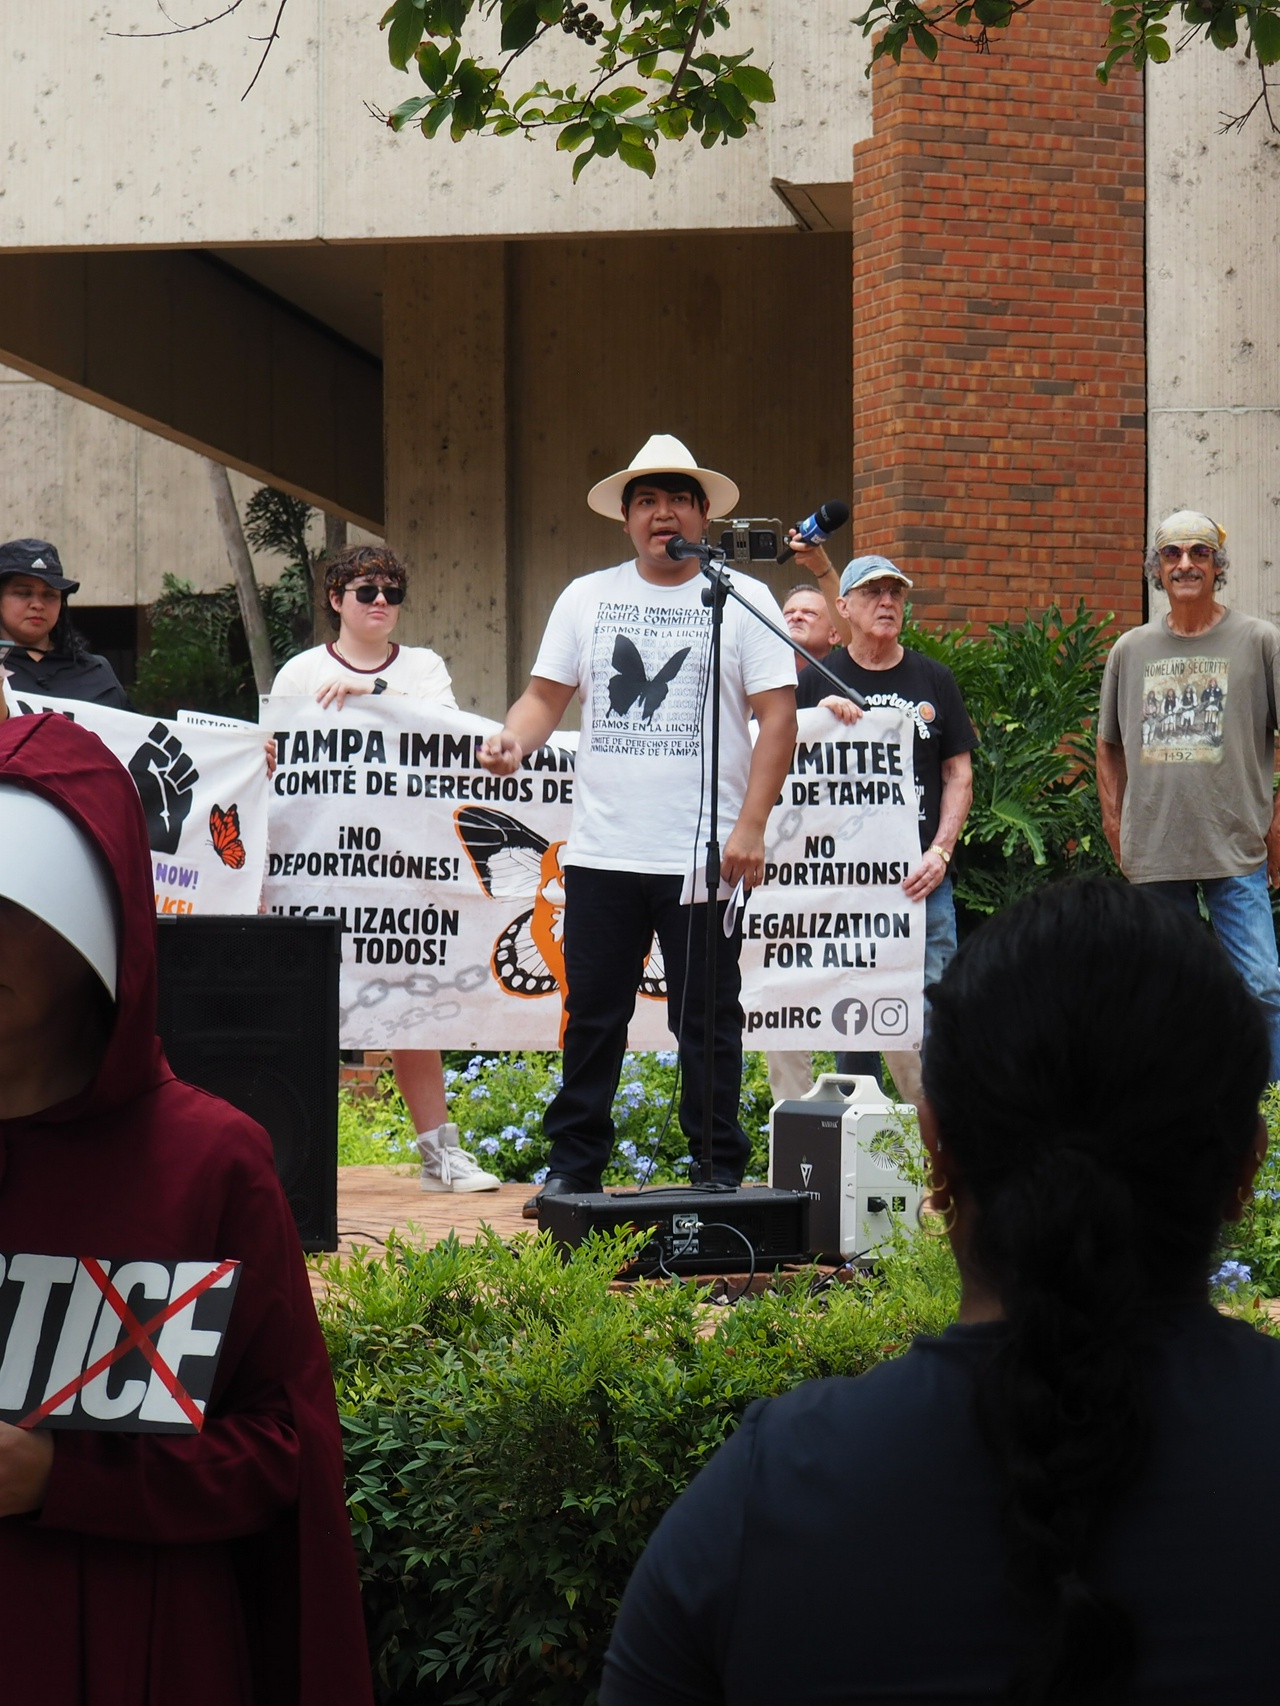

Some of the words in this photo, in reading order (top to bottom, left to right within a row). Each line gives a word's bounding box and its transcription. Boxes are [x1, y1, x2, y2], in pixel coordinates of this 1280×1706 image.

[597, 611, 640, 621] RIGHTS
[599, 602, 640, 613] TAMPA
[645, 606, 711, 616] IMMIGRAN
[595, 626, 641, 635] ESTAMOS
[644, 629, 658, 637] EN
[662, 630, 673, 638] LA
[677, 630, 710, 640] LUCHA
[1144, 662, 1185, 677] HOMELAND
[1188, 660, 1229, 675] SECURITY
[592, 720, 629, 730] ESTAMOS
[632, 722, 646, 732] EN
[650, 723, 662, 732] LA
[666, 723, 700, 733] LUCHA
[273, 728, 387, 765] TAMPA
[399, 732, 577, 773] IMMIAN
[613, 737, 623, 745] DE
[625, 739, 668, 748] DERECHOS
[671, 740, 681, 748] DE
[685, 741, 700, 749] LOS
[648, 747, 660, 756] DE
[663, 747, 699, 757] TAMPA
[788, 741, 903, 776] MITTEE
[1164, 751, 1193, 761] 1492
[274, 765, 357, 796] COMITÉ
[366, 772, 398, 796] DE
[407, 774, 533, 803] DERECHOS
[542, 778, 573, 804] DE
[791, 781, 820, 806] DE
[827, 781, 906, 806] TAMPA
[338, 826, 382, 851] ¡NO
[804, 835, 836, 859] NO
[155, 862, 199, 890] NOW!
[268, 850, 460, 881] DEPORTACIÓNES!
[763, 861, 909, 886] PORTATIONS!
[741, 912, 911, 940] EGALIZATION
[352, 937, 447, 966] TODOS!
[763, 942, 814, 968] FOR
[822, 942, 877, 969] ALL!
[0, 1253, 235, 1424] TICE
